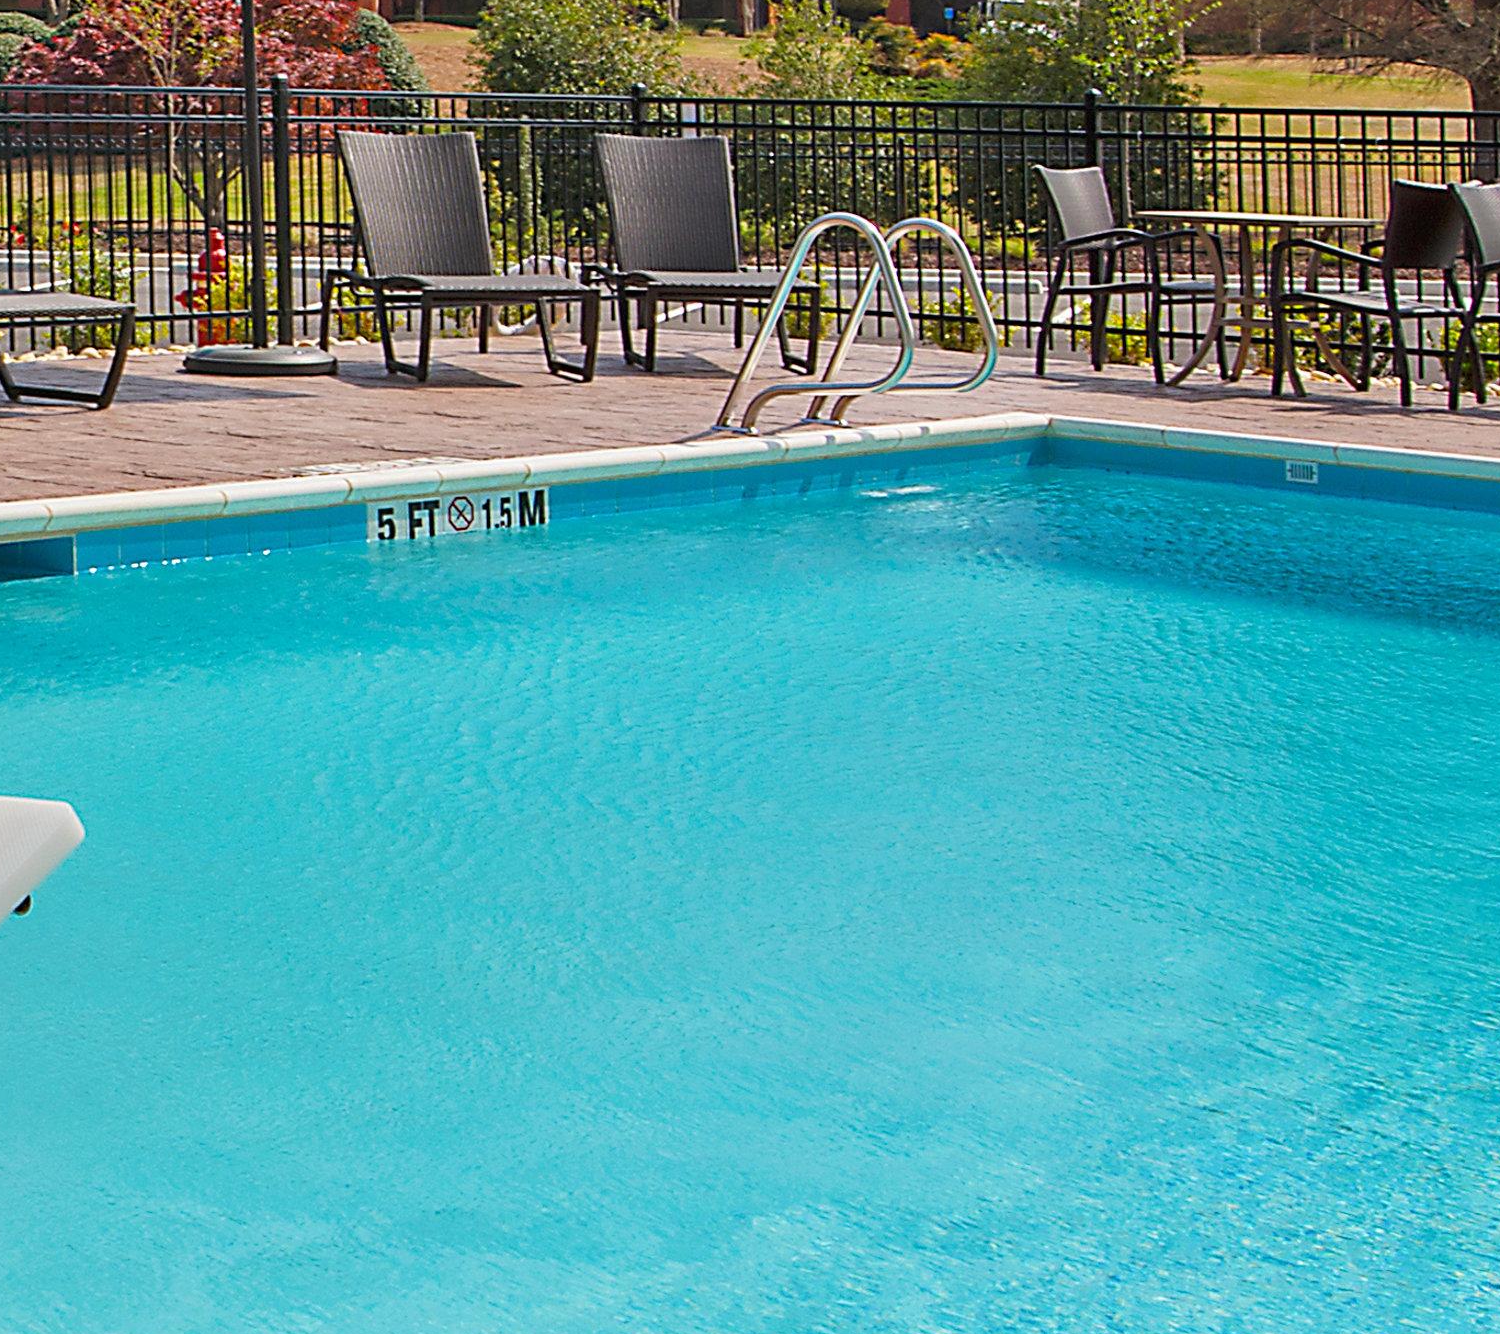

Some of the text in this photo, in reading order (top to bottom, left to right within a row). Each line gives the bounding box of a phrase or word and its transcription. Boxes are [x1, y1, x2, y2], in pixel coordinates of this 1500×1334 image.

[377, 507, 396, 541] 5
[408, 499, 440, 539] FT
[518, 489, 546, 528] M
